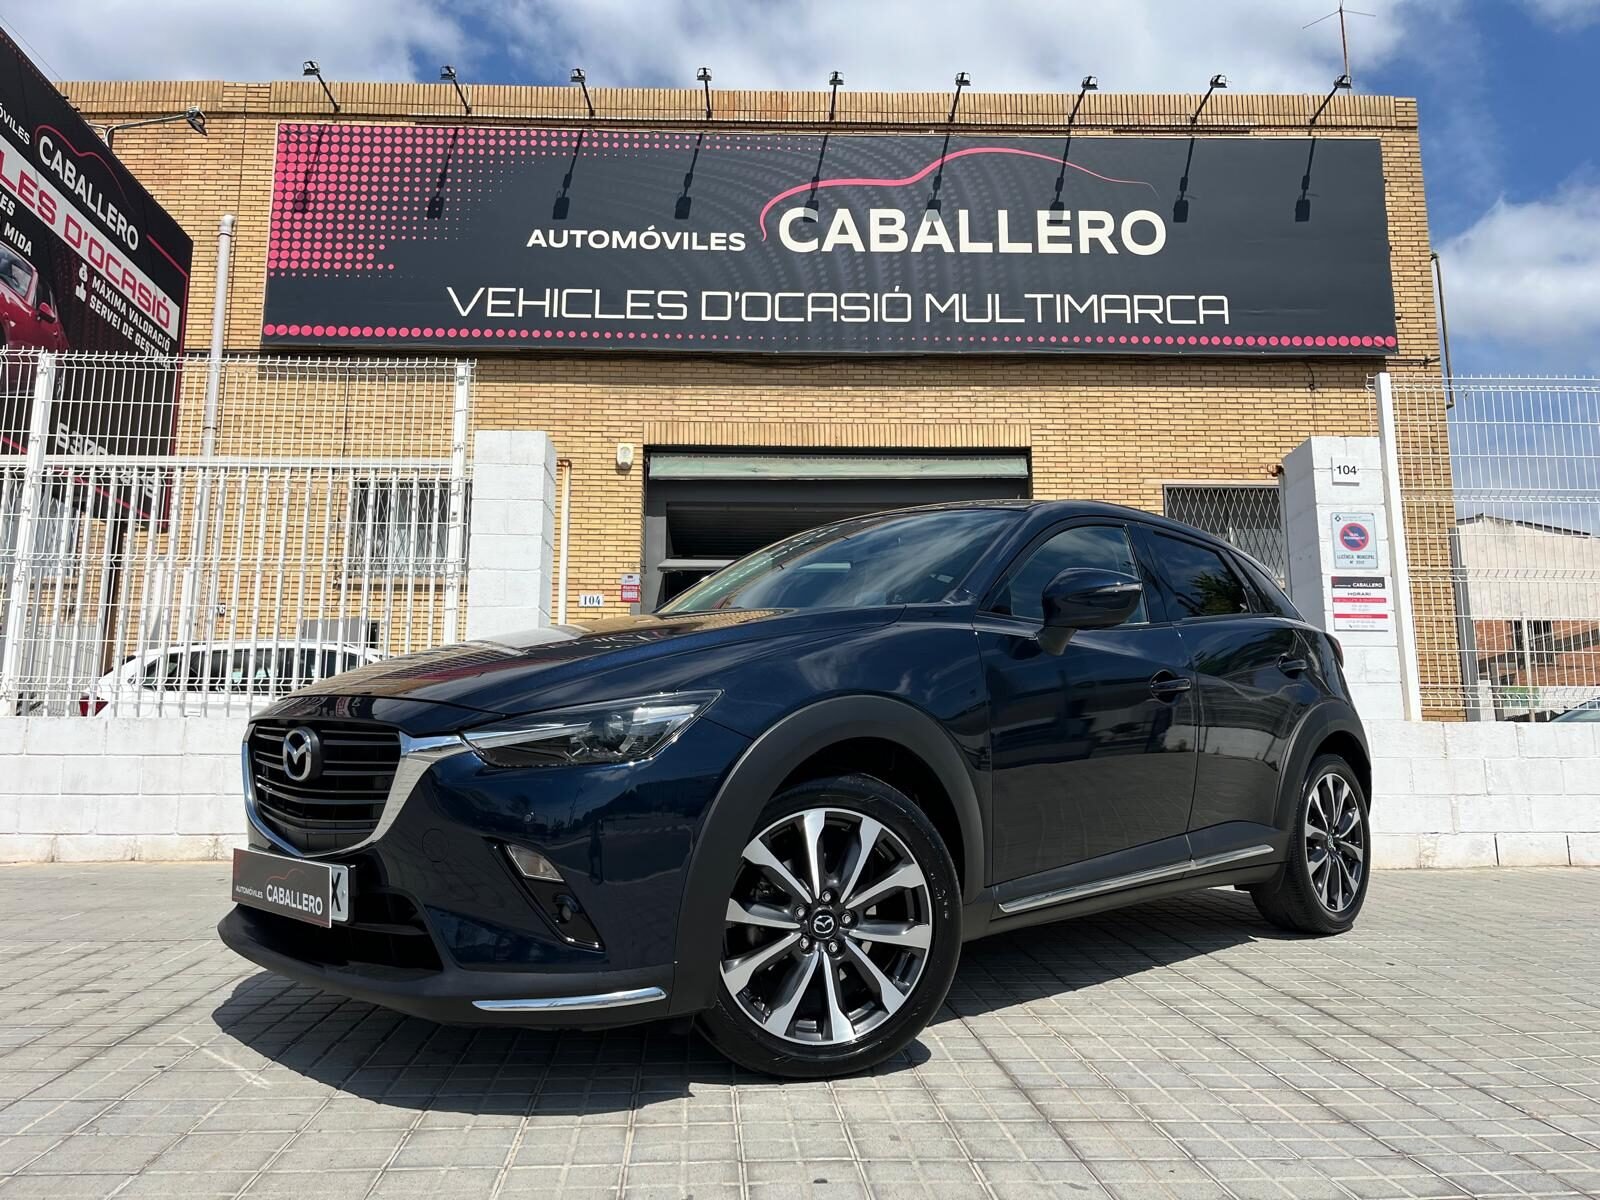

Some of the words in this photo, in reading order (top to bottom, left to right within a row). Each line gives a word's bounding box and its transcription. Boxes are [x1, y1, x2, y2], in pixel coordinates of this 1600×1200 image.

[39, 135, 139, 250] CABALLERO
[4, 222, 33, 257] MIDA
[526, 225, 746, 252] AUTOMÓVILES
[778, 207, 1167, 256] CABALLERO
[64, 213, 170, 329] D'OCASIÓ
[89, 294, 121, 330] SERVEI
[122, 322, 134, 340] DE
[446, 286, 688, 321] VEHICLES
[701, 285, 912, 323] D'OCASIÓ
[129, 307, 171, 351] VALORACIÓ
[1336, 465, 1357, 475] 104
[584, 596, 600, 605] 104
[266, 884, 323, 915] CABALLERO
